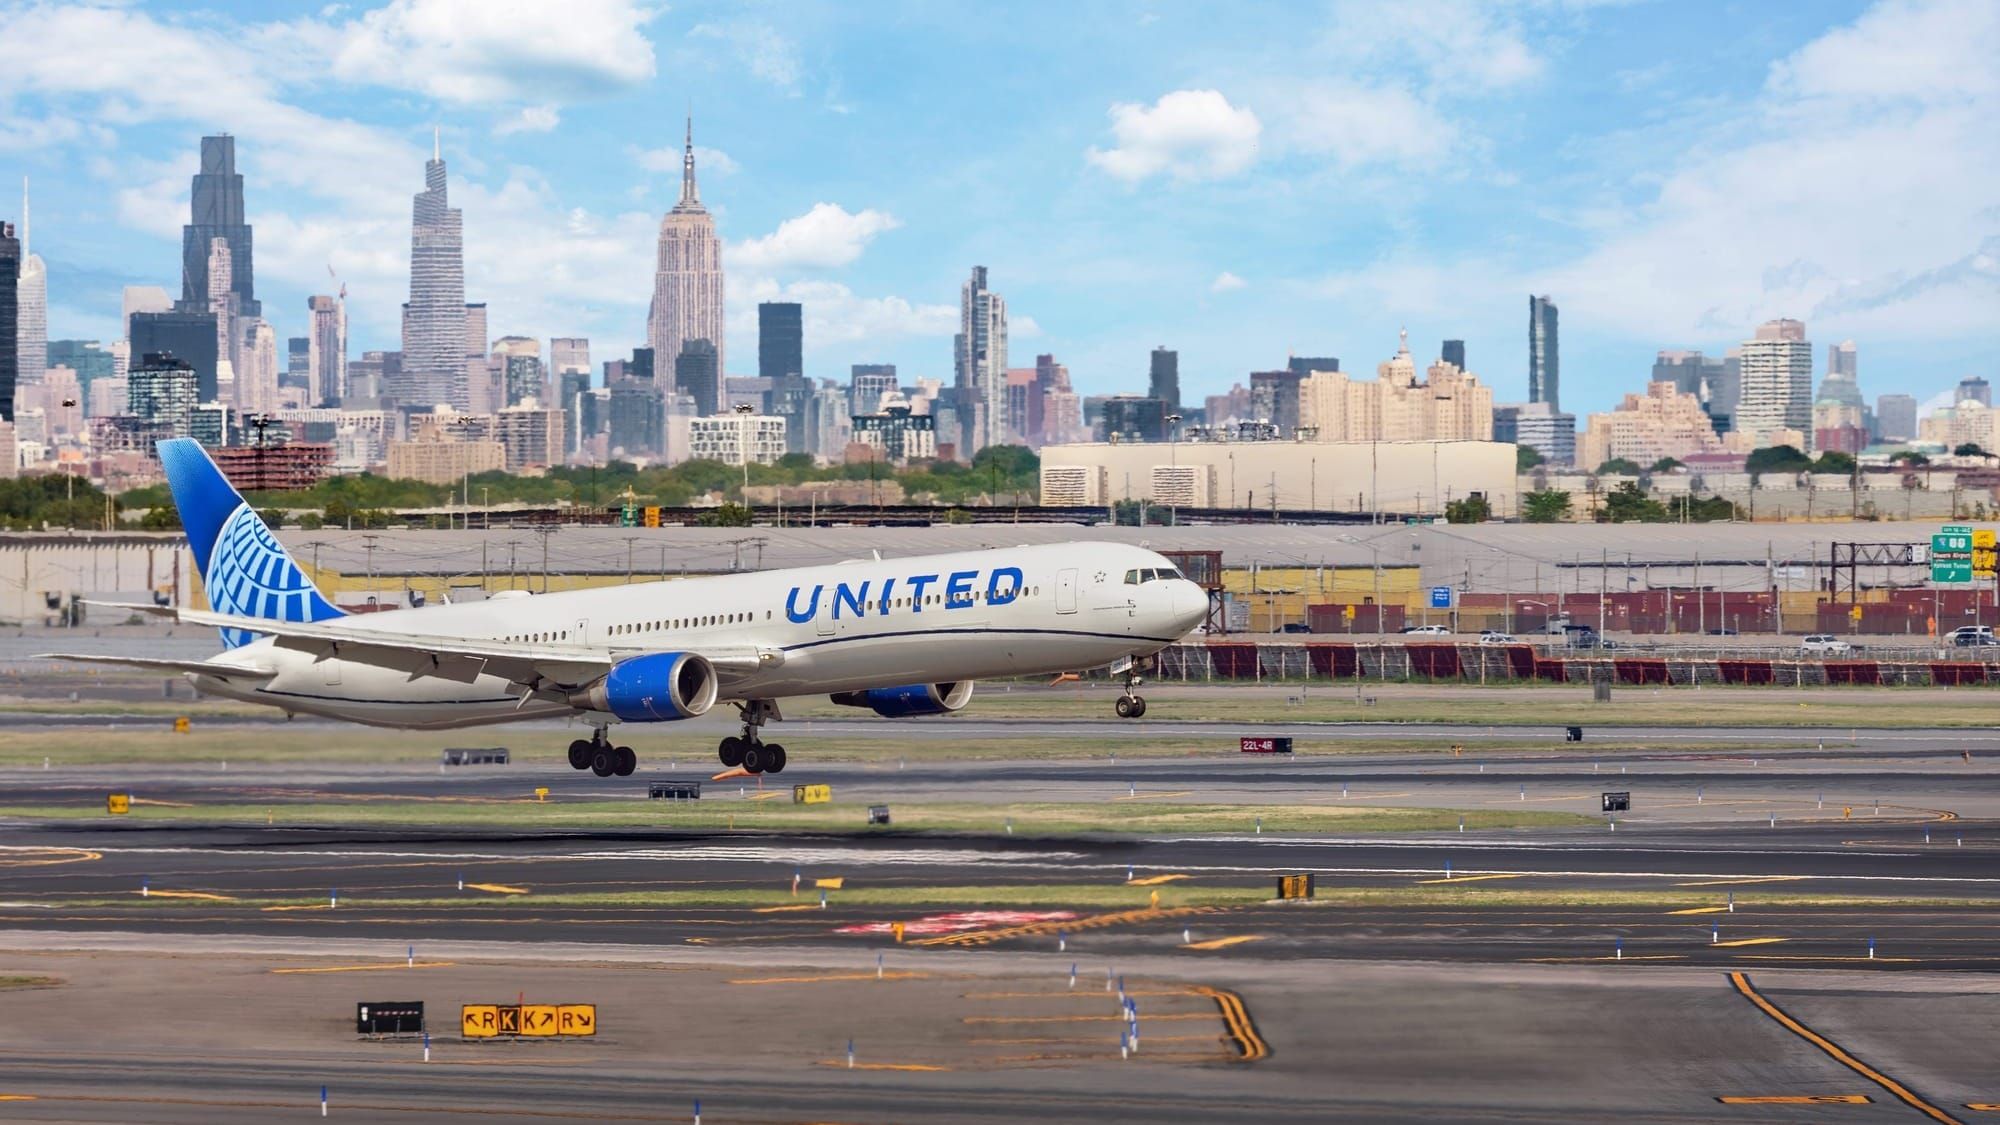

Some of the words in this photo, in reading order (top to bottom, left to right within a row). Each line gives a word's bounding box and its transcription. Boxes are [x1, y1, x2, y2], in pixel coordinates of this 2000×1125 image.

[785, 567, 1023, 624] UNITED
[1242, 741, 1273, 750] 22L-4R
[483, 1012, 494, 1029] R
[502, 1011, 515, 1030] K
[524, 1011, 535, 1029] K
[563, 1012, 573, 1028] R
